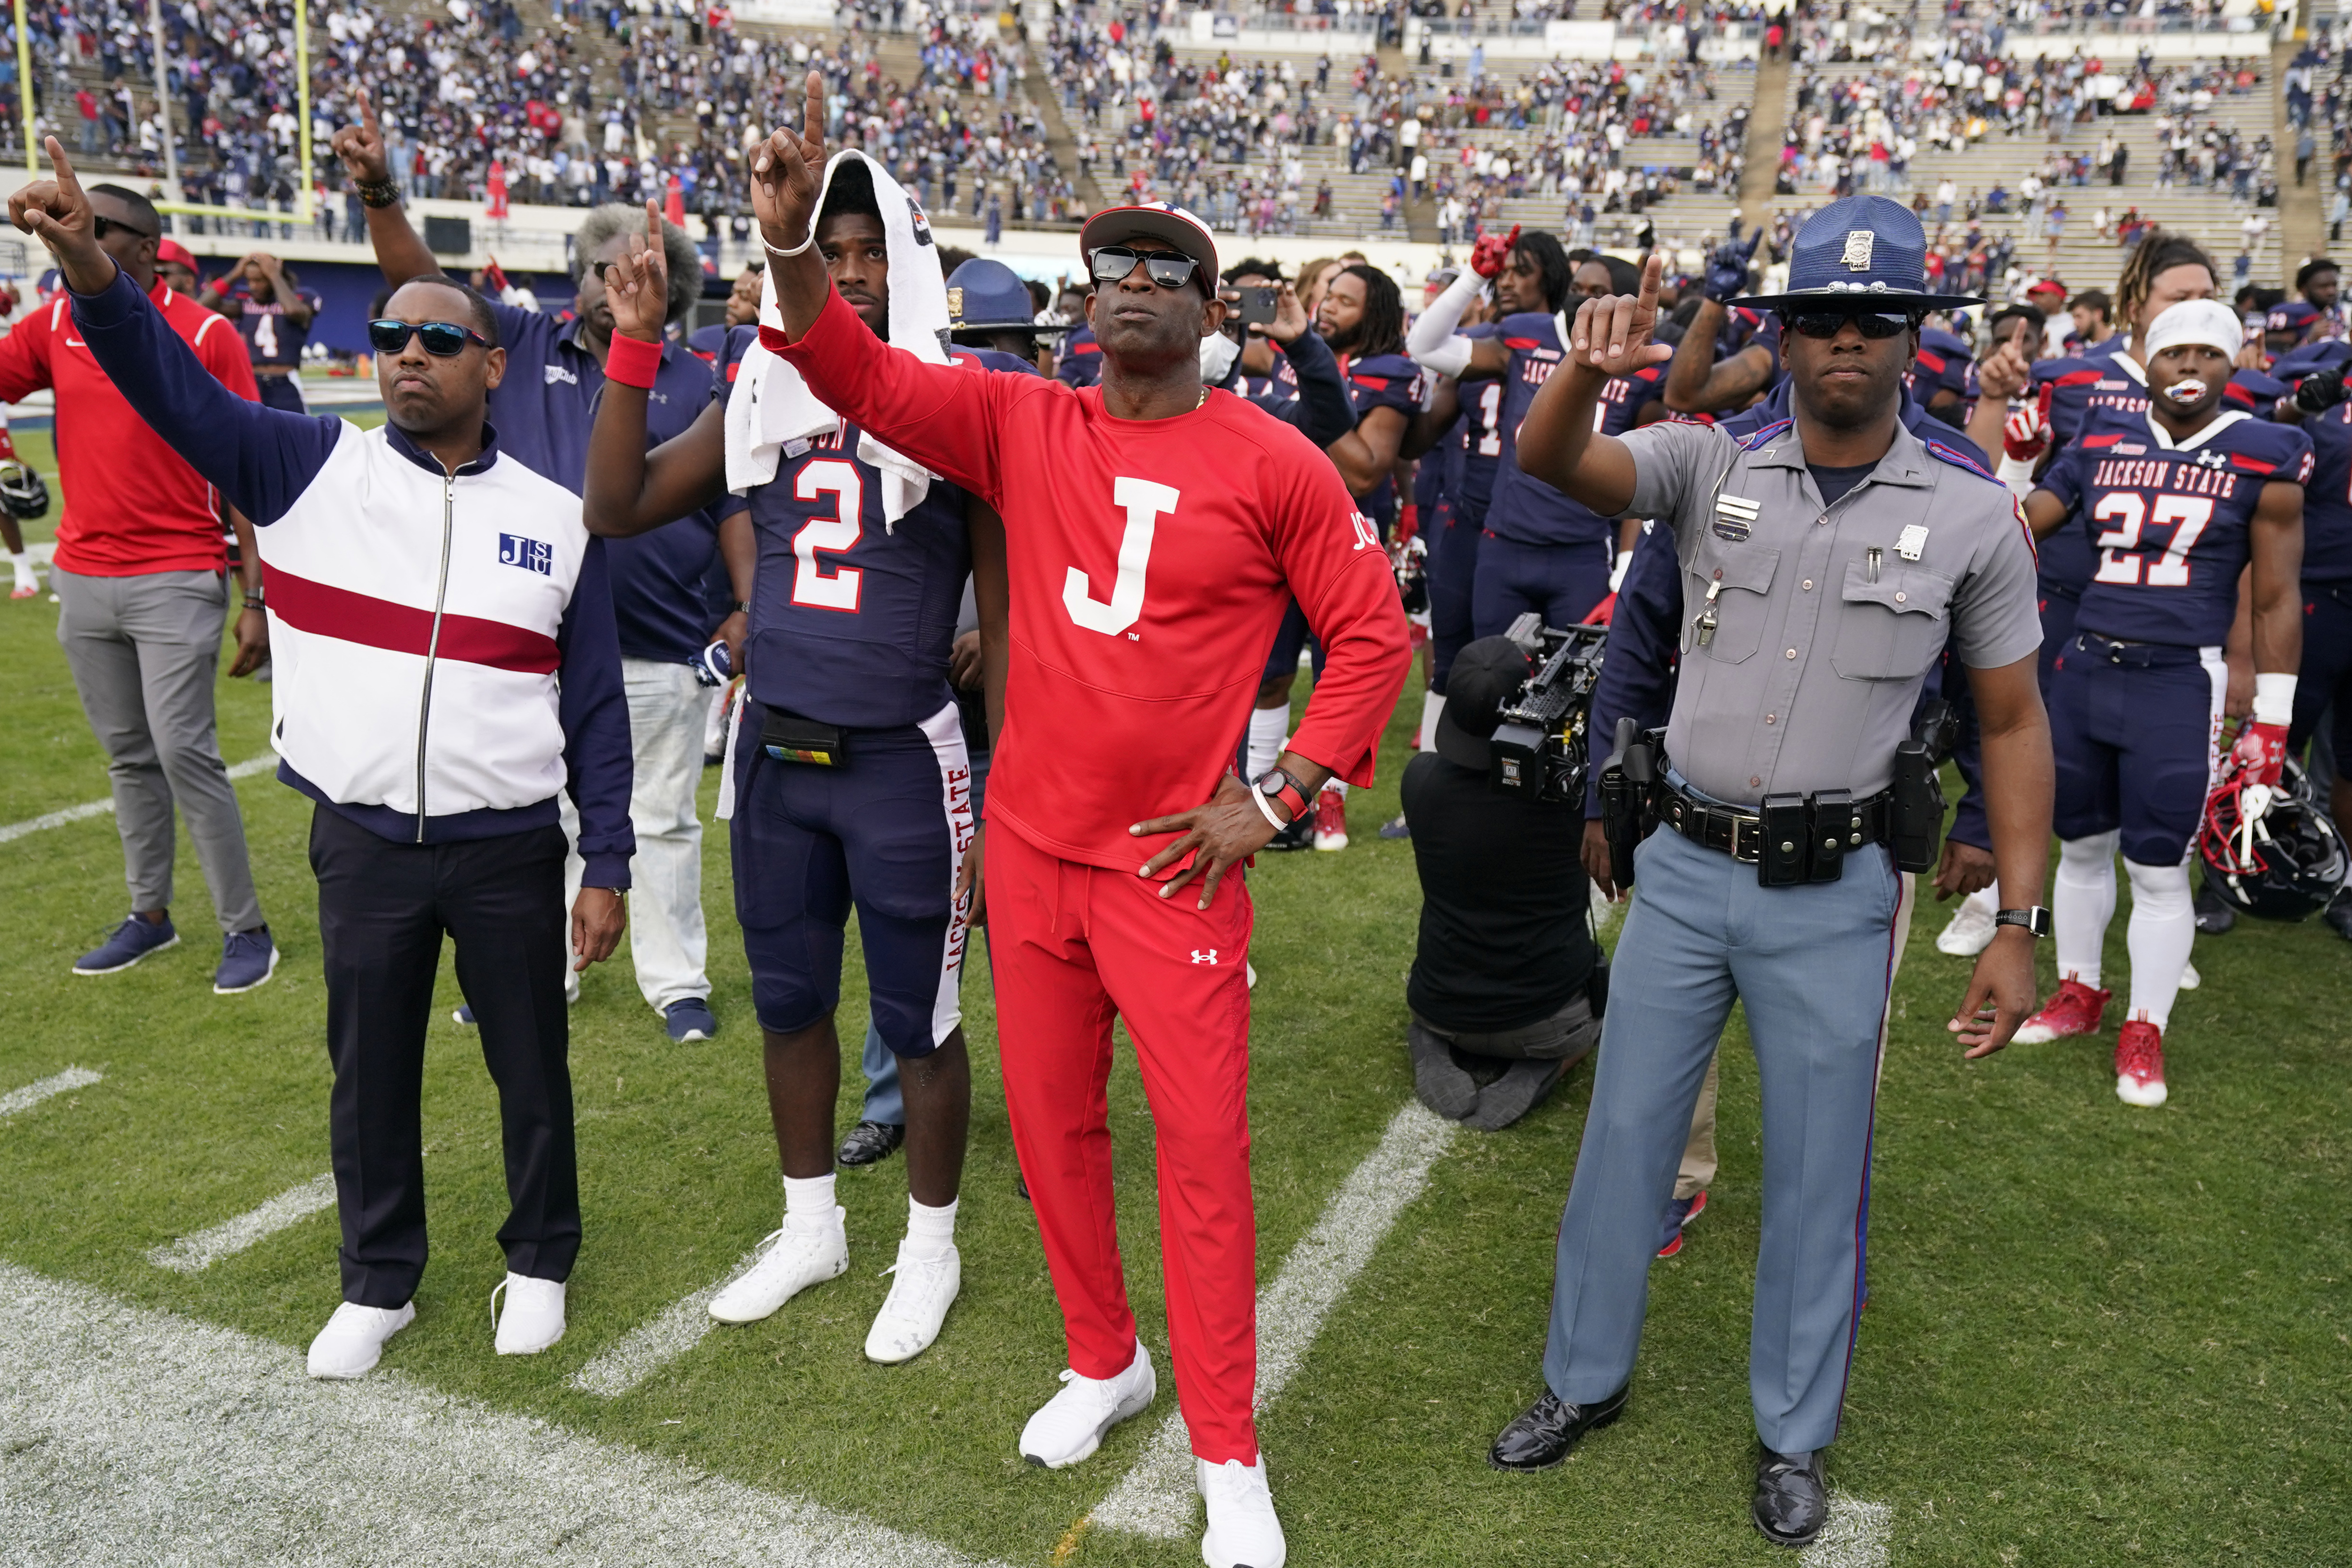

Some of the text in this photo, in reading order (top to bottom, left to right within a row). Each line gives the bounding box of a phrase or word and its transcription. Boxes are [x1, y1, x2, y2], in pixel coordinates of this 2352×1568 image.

[254, 313, 278, 357] 4
[2093, 460, 2237, 499] JACKSON STATE
[790, 457, 864, 614] 2
[1062, 476, 1181, 637] J
[2094, 492, 2215, 587] 27
[1128, 632, 1140, 642] TM
